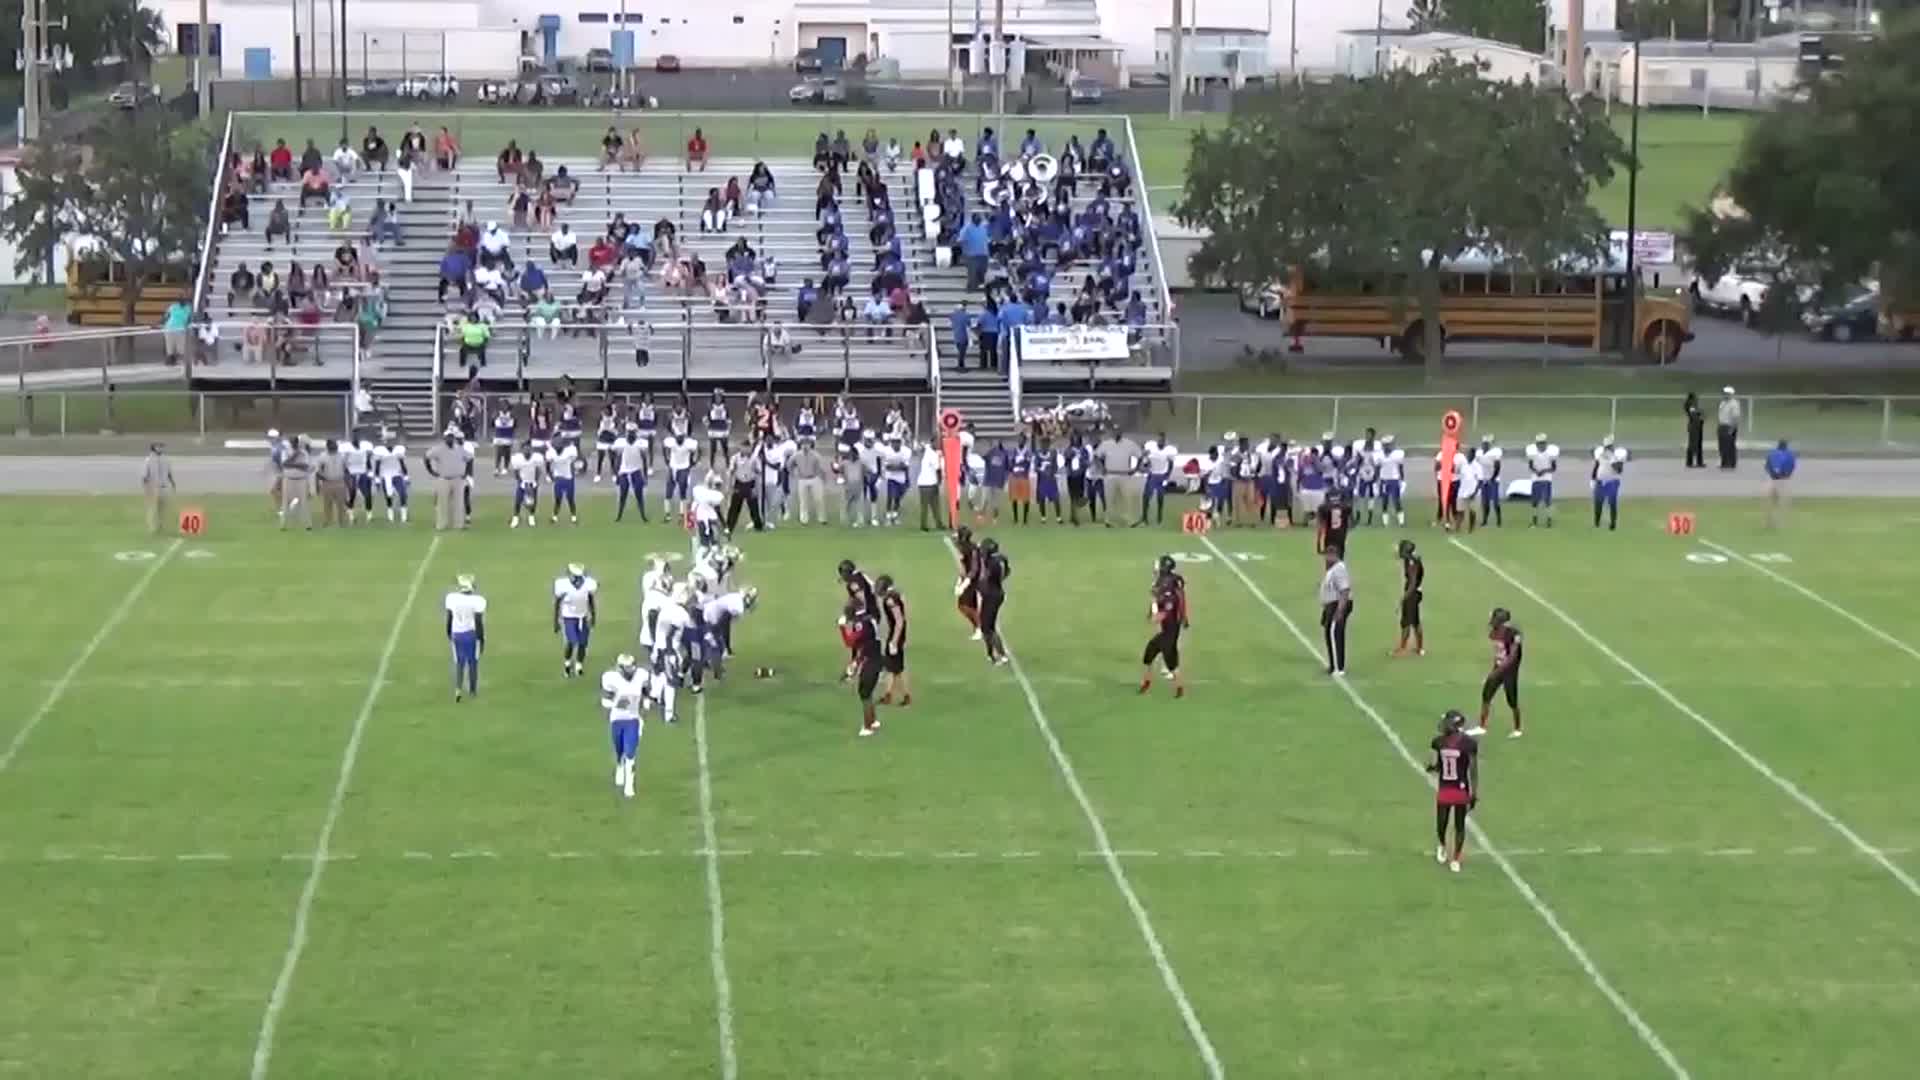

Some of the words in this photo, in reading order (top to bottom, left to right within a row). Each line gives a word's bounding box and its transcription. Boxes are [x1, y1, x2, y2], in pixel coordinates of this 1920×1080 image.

[182, 515, 200, 534] 40
[1186, 515, 1205, 533] 40
[1672, 516, 1690, 534] 30
